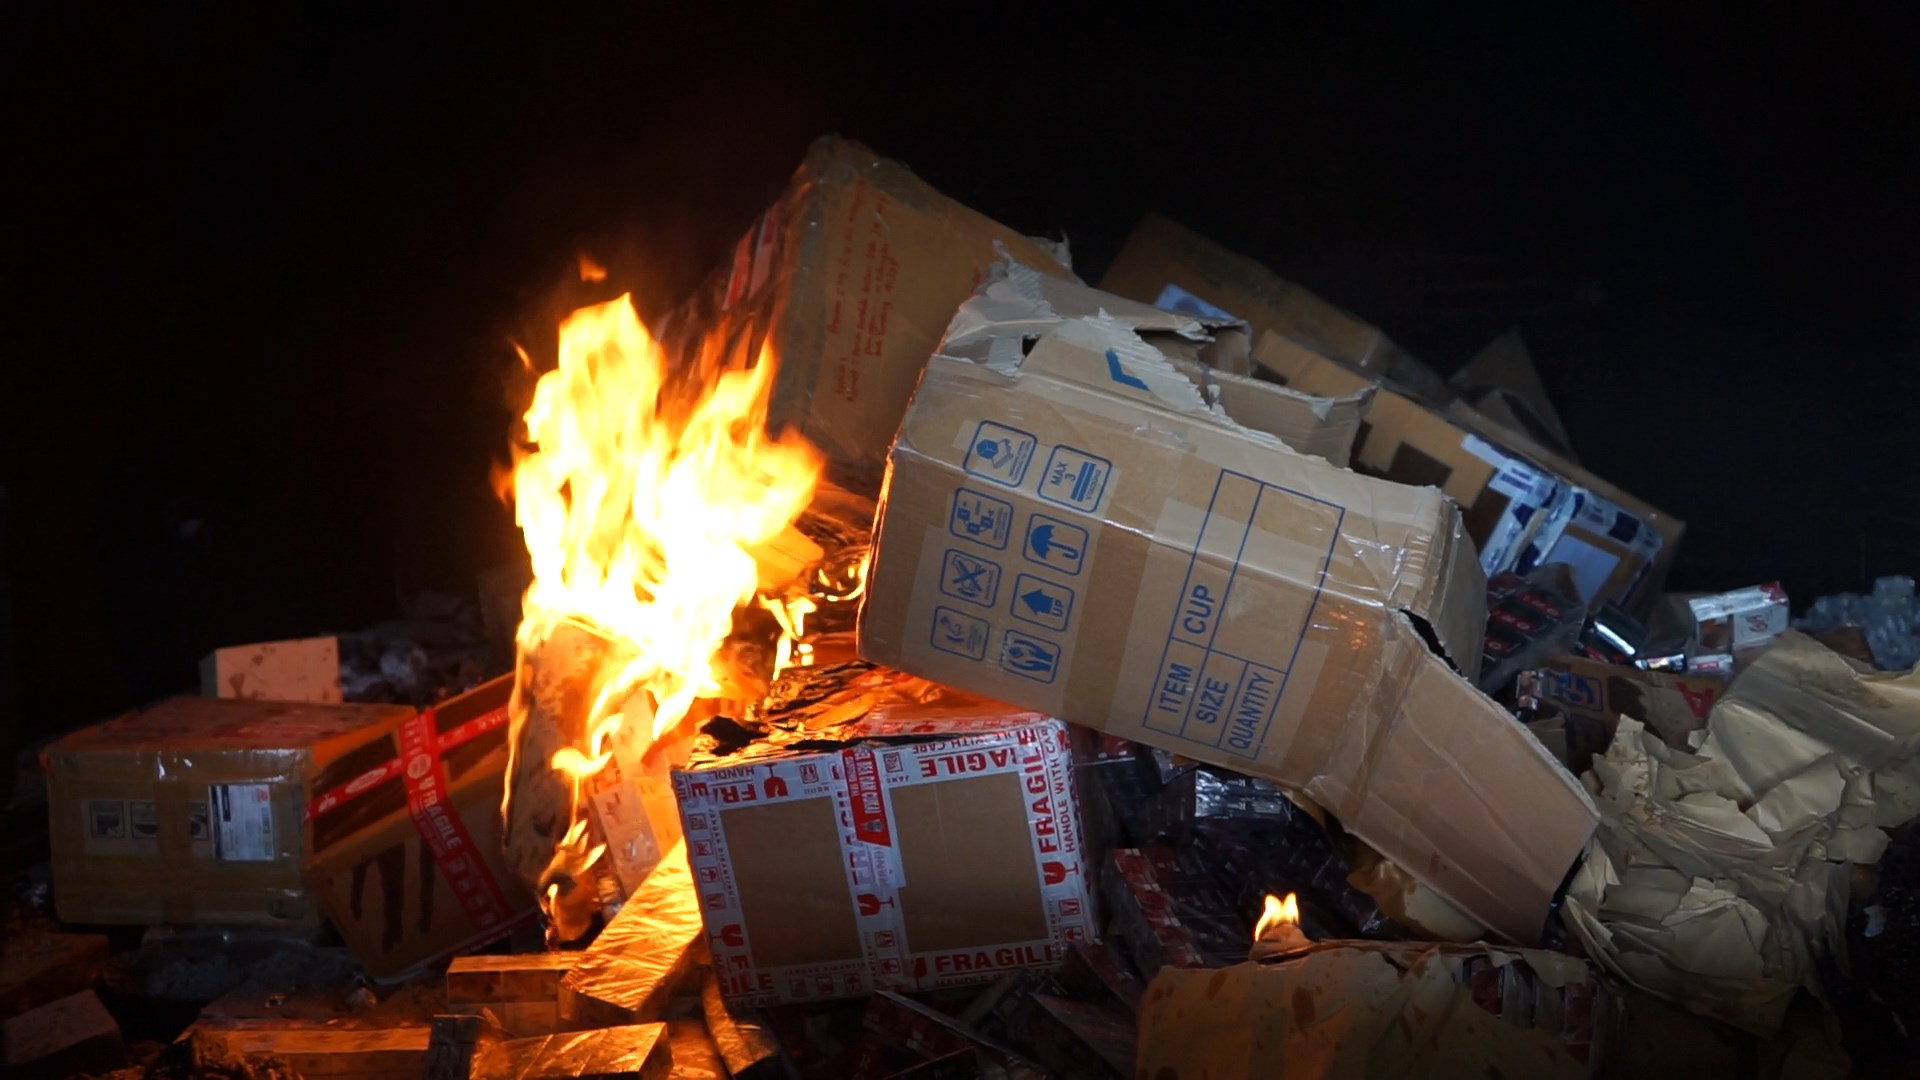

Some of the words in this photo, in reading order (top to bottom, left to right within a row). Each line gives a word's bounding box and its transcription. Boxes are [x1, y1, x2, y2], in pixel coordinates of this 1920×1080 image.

[1051, 461, 1068, 486] MAX
[1065, 473, 1076, 482] 3
[1052, 599, 1064, 617] UP
[1183, 584, 1215, 634] CUP
[1158, 662, 1192, 713] ITEM
[1195, 677, 1230, 724] SIZE
[1228, 672, 1274, 750] QUANTITY
[1041, 728, 1056, 754] CAR
[713, 766, 755, 780] HANDL
[919, 748, 1017, 778] AGILE
[1050, 758, 1065, 794] WITH
[1017, 728, 1057, 853] FRAGILE
[422, 789, 463, 848] FRAGILE
[1058, 799, 1075, 853] HANDLE
